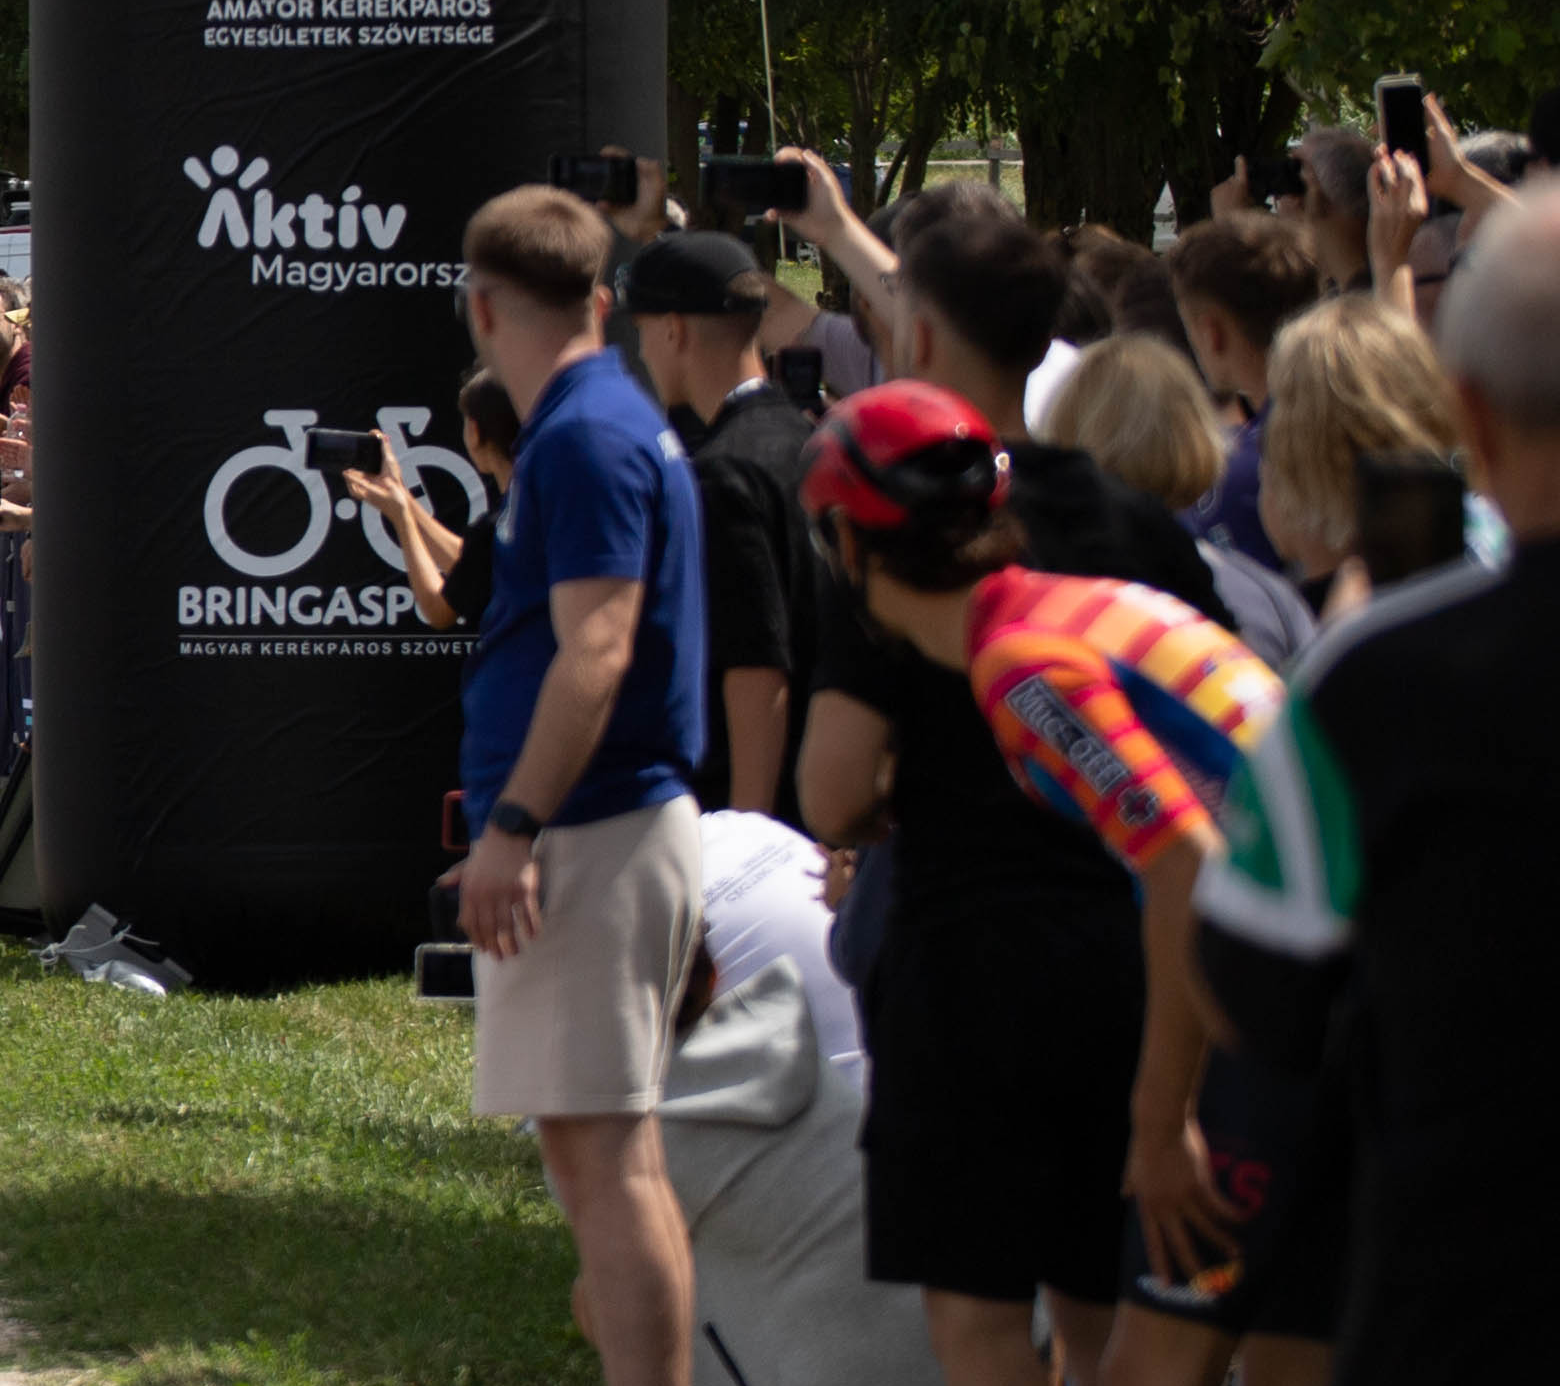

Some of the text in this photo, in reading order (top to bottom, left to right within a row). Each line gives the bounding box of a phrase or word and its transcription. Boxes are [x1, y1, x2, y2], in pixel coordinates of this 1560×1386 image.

[252, 253, 471, 293] Magyarorsz
[180, 641, 252, 655] MAGYAR
[260, 639, 393, 656] KERÉKPÁROS
